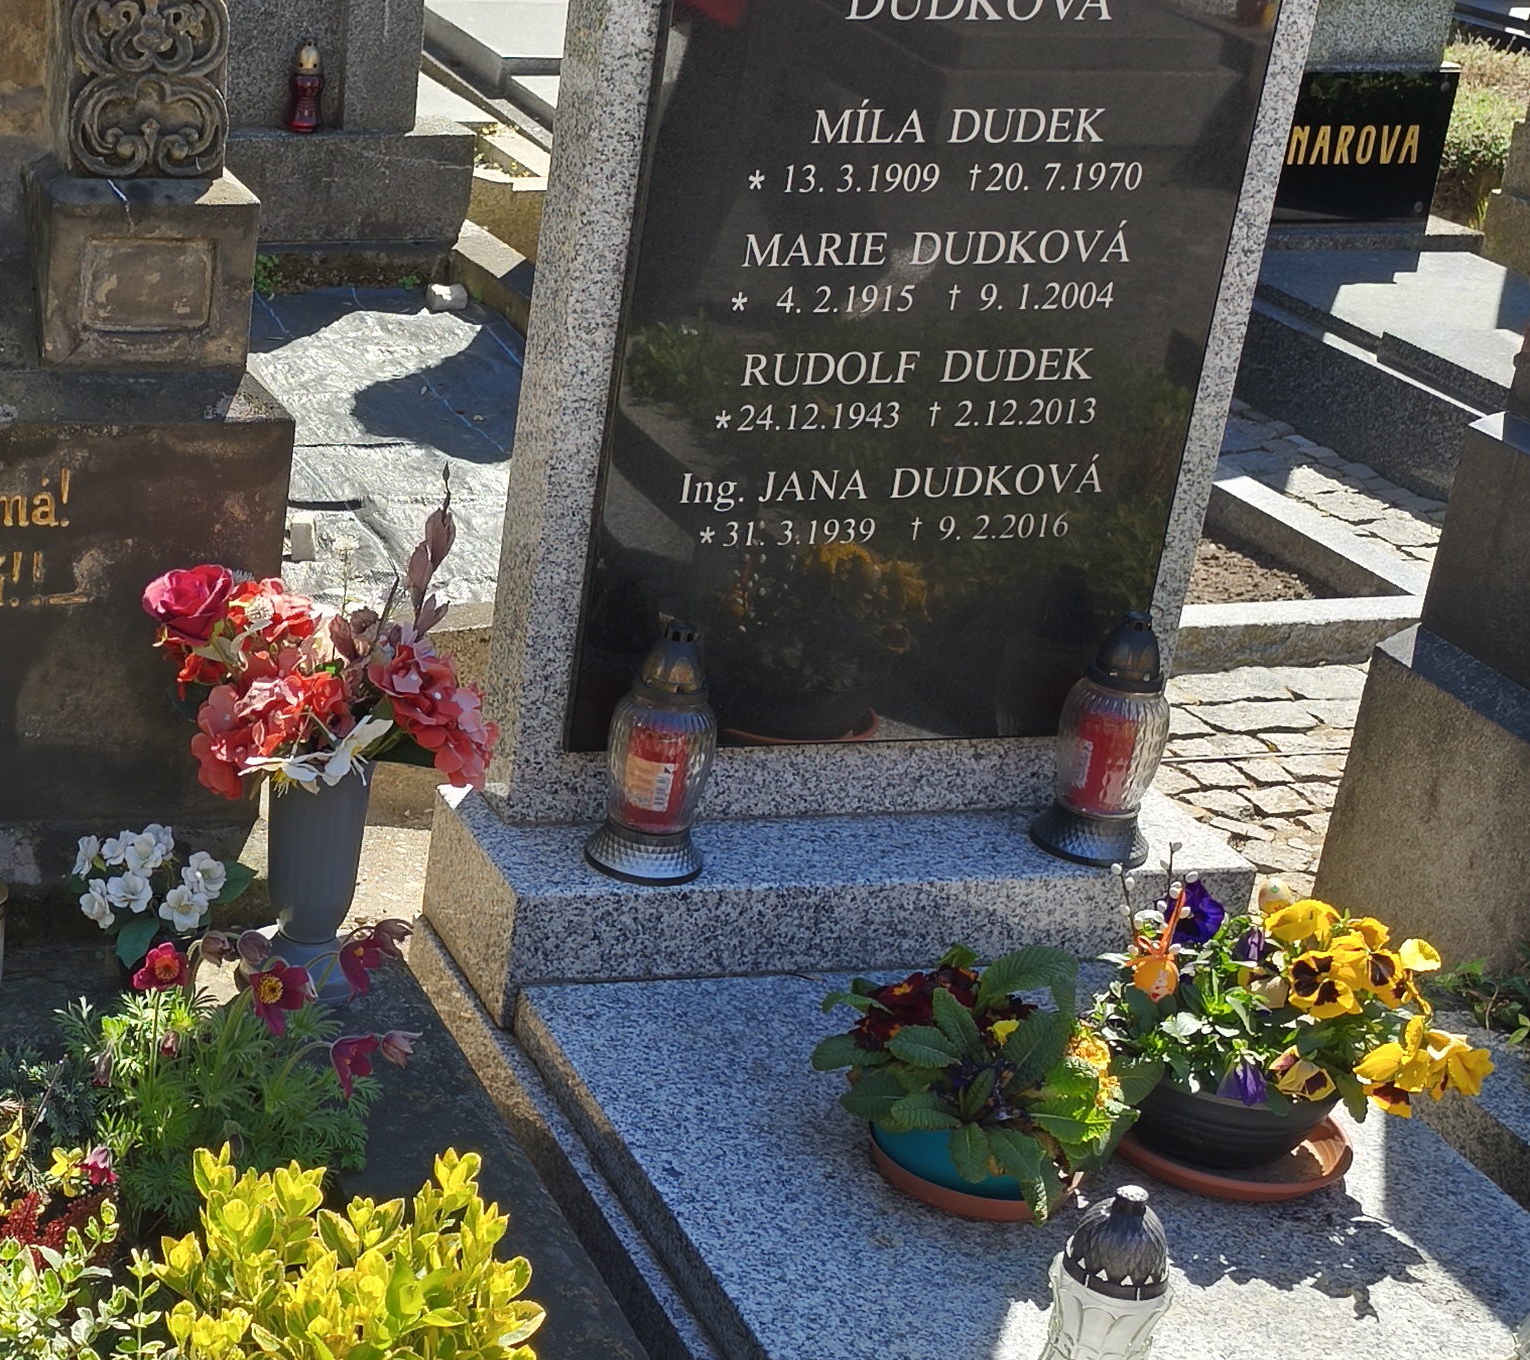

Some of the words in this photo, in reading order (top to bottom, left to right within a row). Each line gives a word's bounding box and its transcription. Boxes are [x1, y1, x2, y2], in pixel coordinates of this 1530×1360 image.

[811, 98, 926, 144] MÍLA
[947, 108, 1107, 144] DUDEK
[1286, 124, 1420, 165] NAROVA
[741, 231, 888, 268] MARIE
[909, 220, 1130, 266] DUDKOVÁ
[741, 350, 921, 388] RUDOLF
[939, 347, 1094, 383] DUDEK
[954, 397, 1097, 427] 2.12.2013
[679, 472, 745, 512] Ing.
[758, 469, 869, 503] JANA
[889, 454, 1102, 499] DUDKOVÁ
